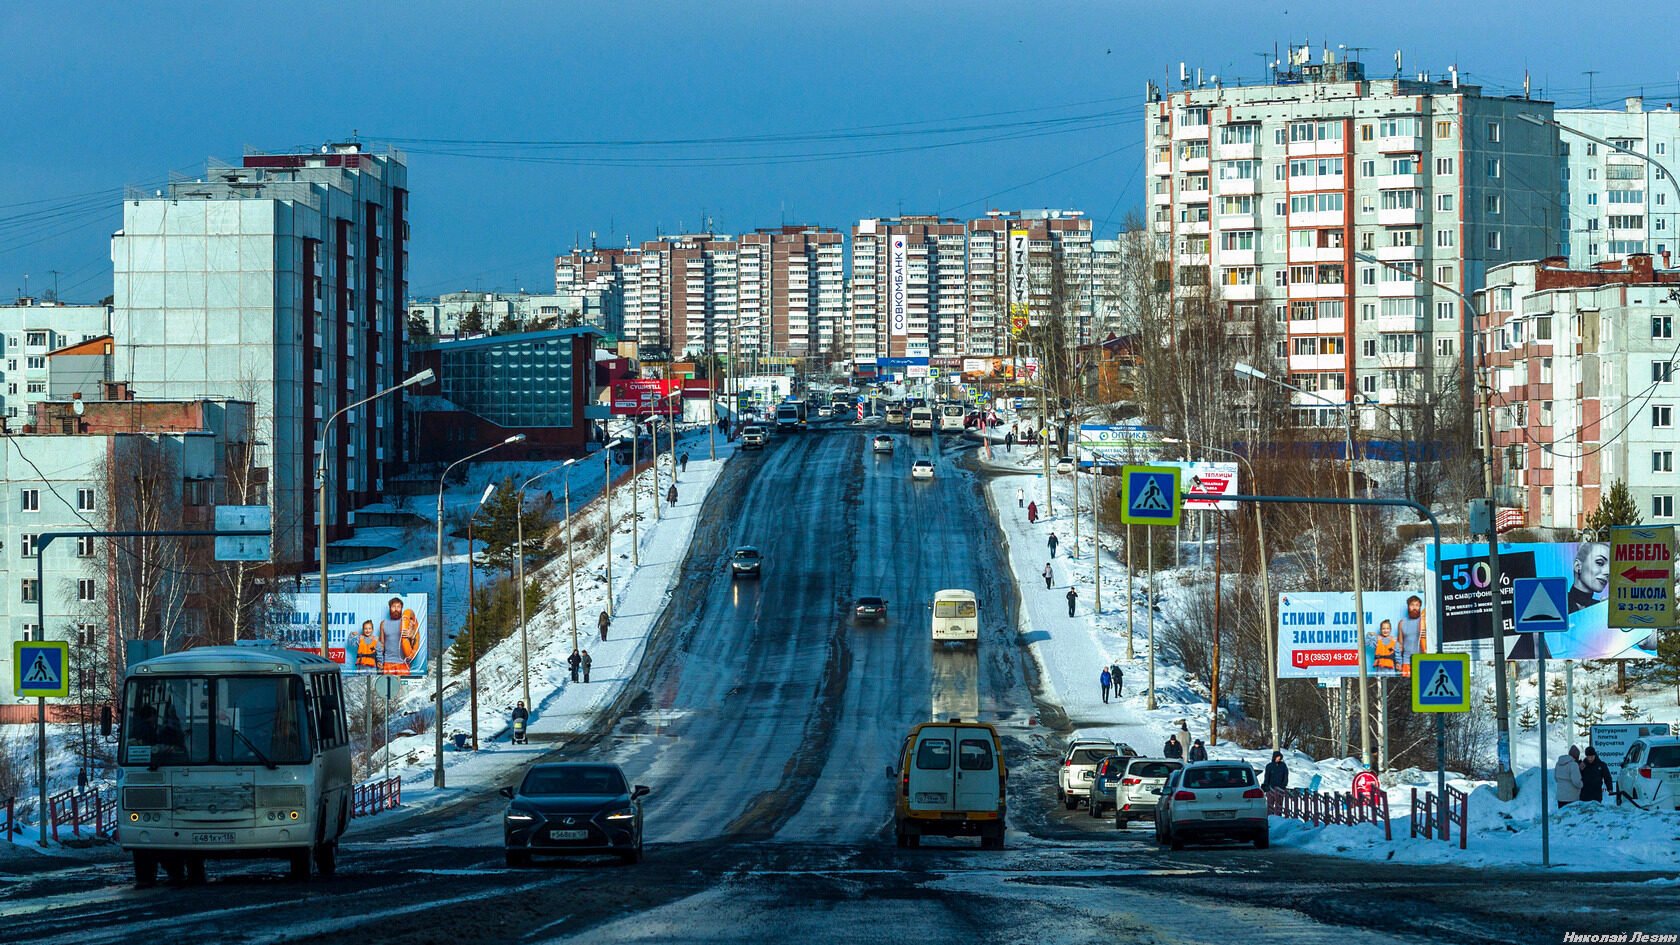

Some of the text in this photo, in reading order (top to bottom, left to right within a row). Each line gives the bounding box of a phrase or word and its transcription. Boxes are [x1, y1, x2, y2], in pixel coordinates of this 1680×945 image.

[895, 252, 903, 330] СОВКОМБАНК
[1111, 431, 1147, 439] ОПТИКА
[1615, 543, 1671, 561] МЕБЕЛЬ
[1617, 587, 1667, 599] 11 ШКОЛА
[1628, 603, 1665, 612] 3-02-12
[1282, 611, 1373, 626] СПИШИ ДОЛИ
[1292, 630, 1358, 643] ЗАКОННО!!
[1304, 652, 1359, 663] 8 (3953) 49-02-7
